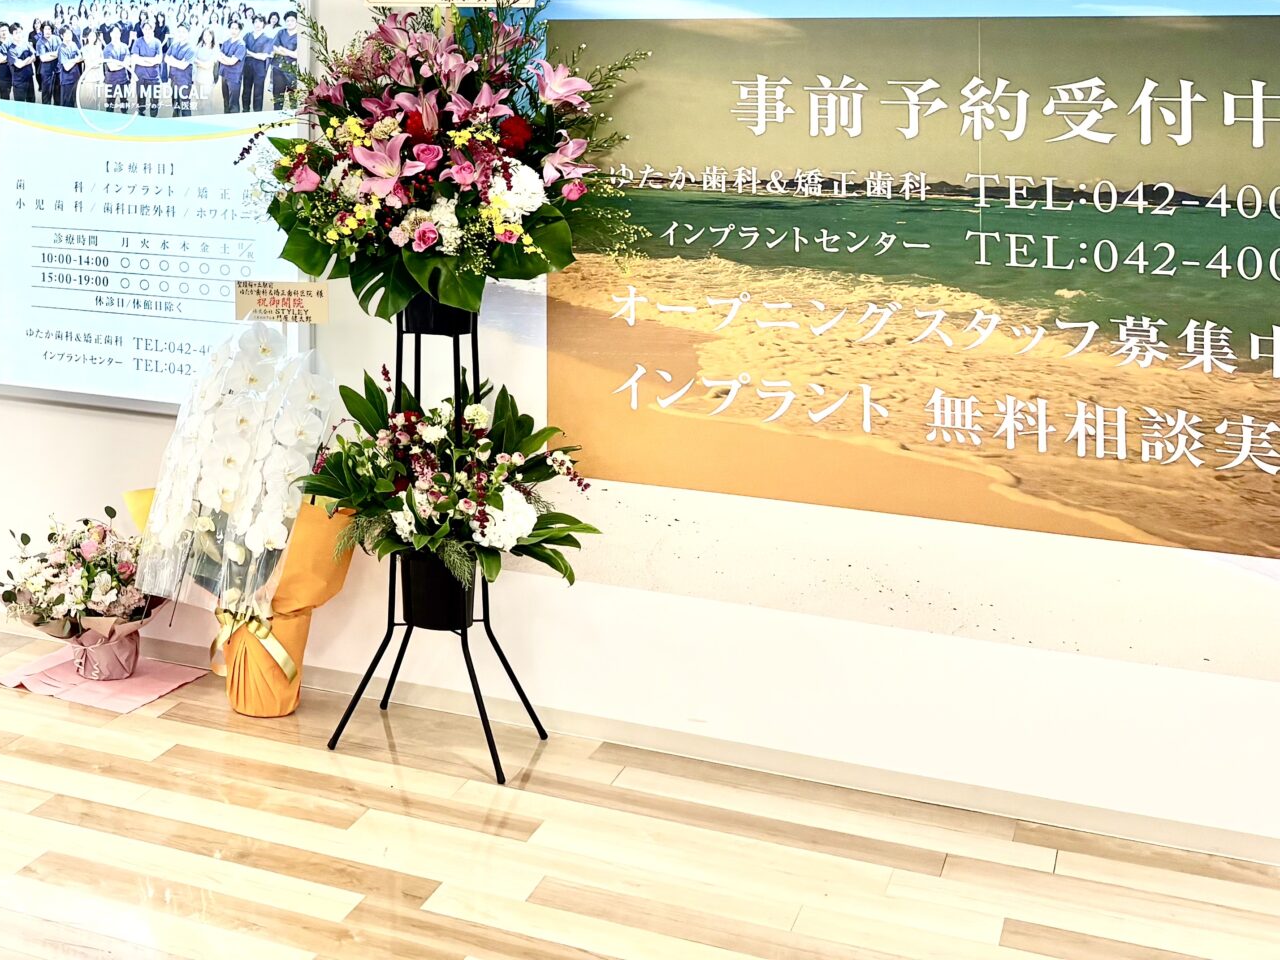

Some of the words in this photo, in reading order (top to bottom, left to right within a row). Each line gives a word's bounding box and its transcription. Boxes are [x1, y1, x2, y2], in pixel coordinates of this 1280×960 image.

[95, 84, 135, 98] TEAM
[140, 85, 208, 100] MEDICAL
[730, 74, 1280, 150] 事前予約受付中
[103, 183, 174, 197] インプラント
[609, 163, 931, 202] ゆたか歯科&矯正歯科
[103, 202, 176, 218] 歯科口腔外科
[53, 233, 98, 246] 診療時間
[140, 238, 150, 249] 火
[160, 239, 170, 250] 水
[180, 241, 189, 251] 木
[200, 242, 209, 253] 金
[220, 243, 230, 254] 土
[660, 221, 931, 256] インプラントセンター
[41, 252, 109, 268] 10:00-14:00
[41, 271, 109, 287] 15:00-19:00
[95, 296, 183, 313] 休診日/休館日除く
[26, 328, 123, 347] ゆたか歯科&矯正歯科
[42, 350, 123, 366] インプラントセンター
[611, 363, 888, 433] インプラント
[924, 387, 1280, 476] 無料相談実
